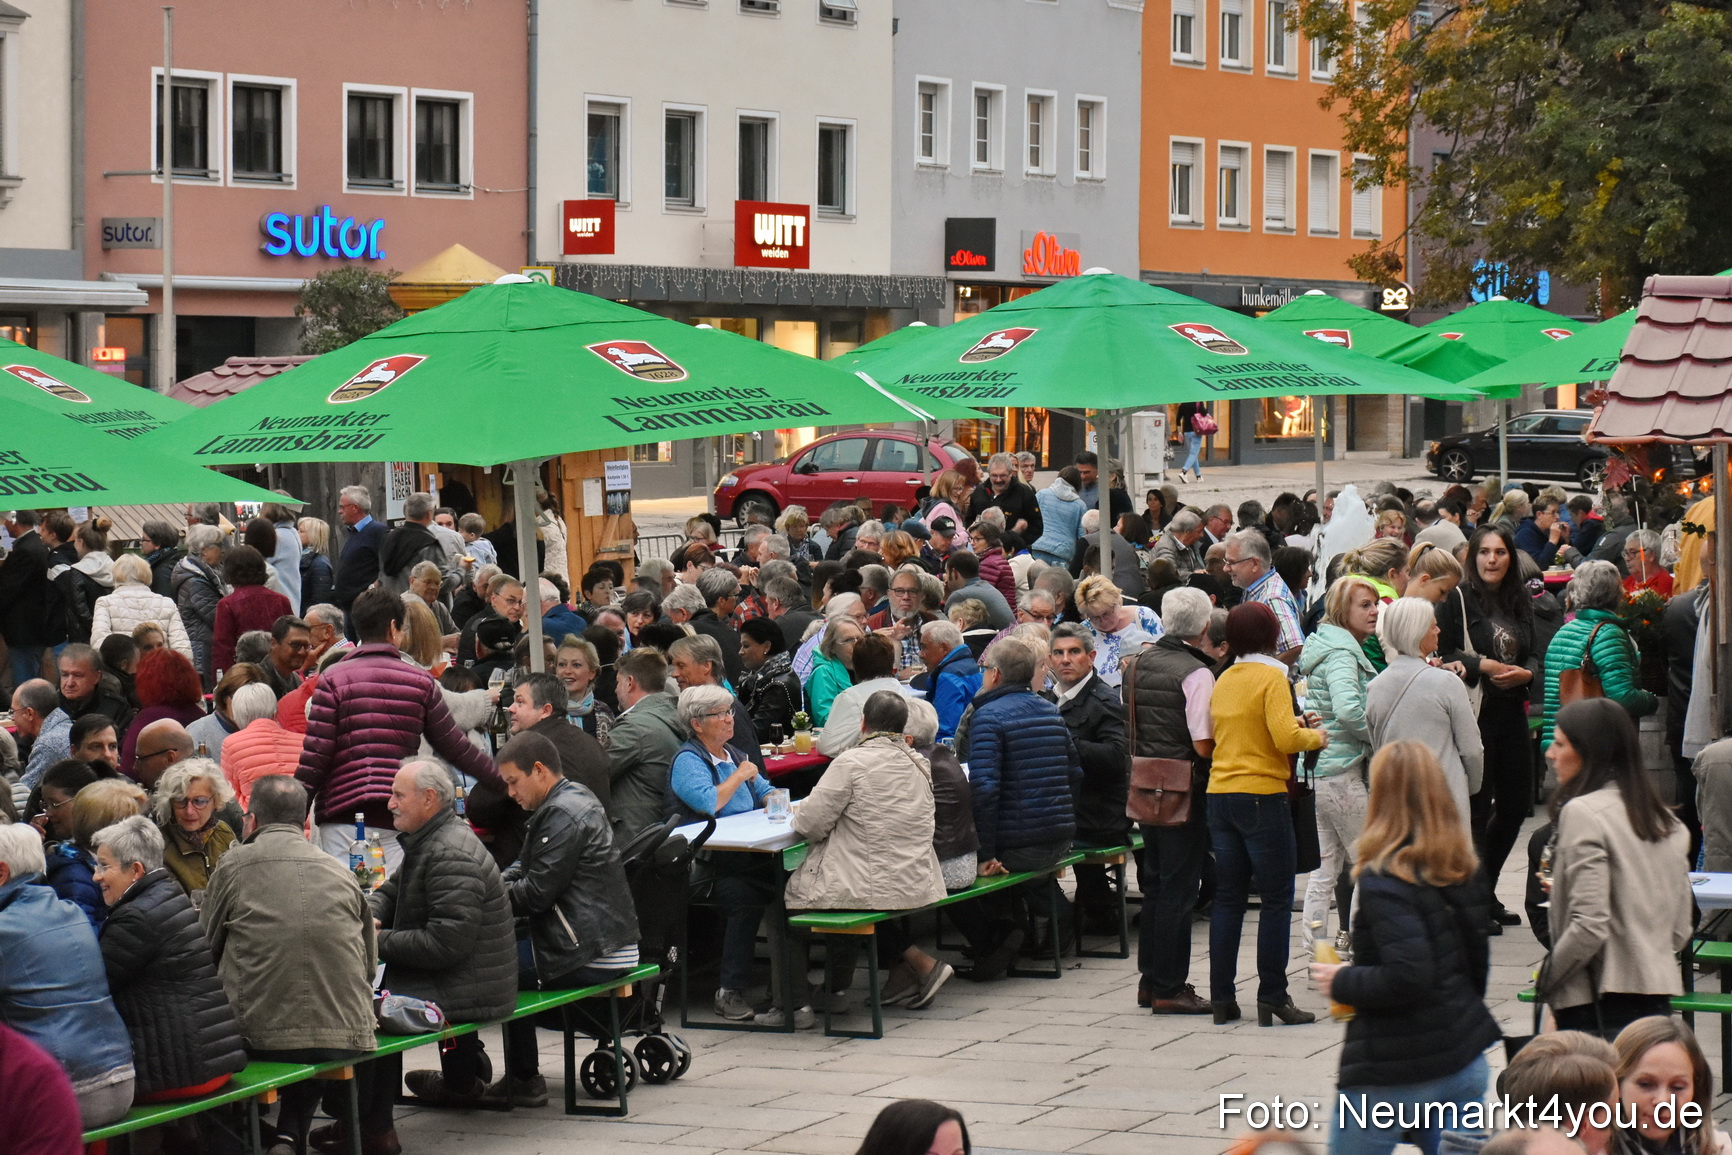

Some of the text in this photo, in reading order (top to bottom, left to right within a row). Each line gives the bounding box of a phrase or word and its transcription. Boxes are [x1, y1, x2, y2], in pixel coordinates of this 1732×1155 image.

[569, 217, 601, 232] WITT
[754, 213, 806, 247] WITT
[761, 247, 789, 259] weiden
[1242, 286, 1300, 307] hunkemölle
[649, 370, 678, 380] 1628
[894, 369, 1017, 385] Neumarkter
[1197, 360, 1314, 376] Neumarkter
[1194, 372, 1362, 392] Lammsbräu
[610, 386, 773, 411] Neumarkter
[249, 410, 391, 432] Neumarkter
[601, 399, 833, 434] Lammsbräu
[193, 428, 387, 456] Lammsbräu
